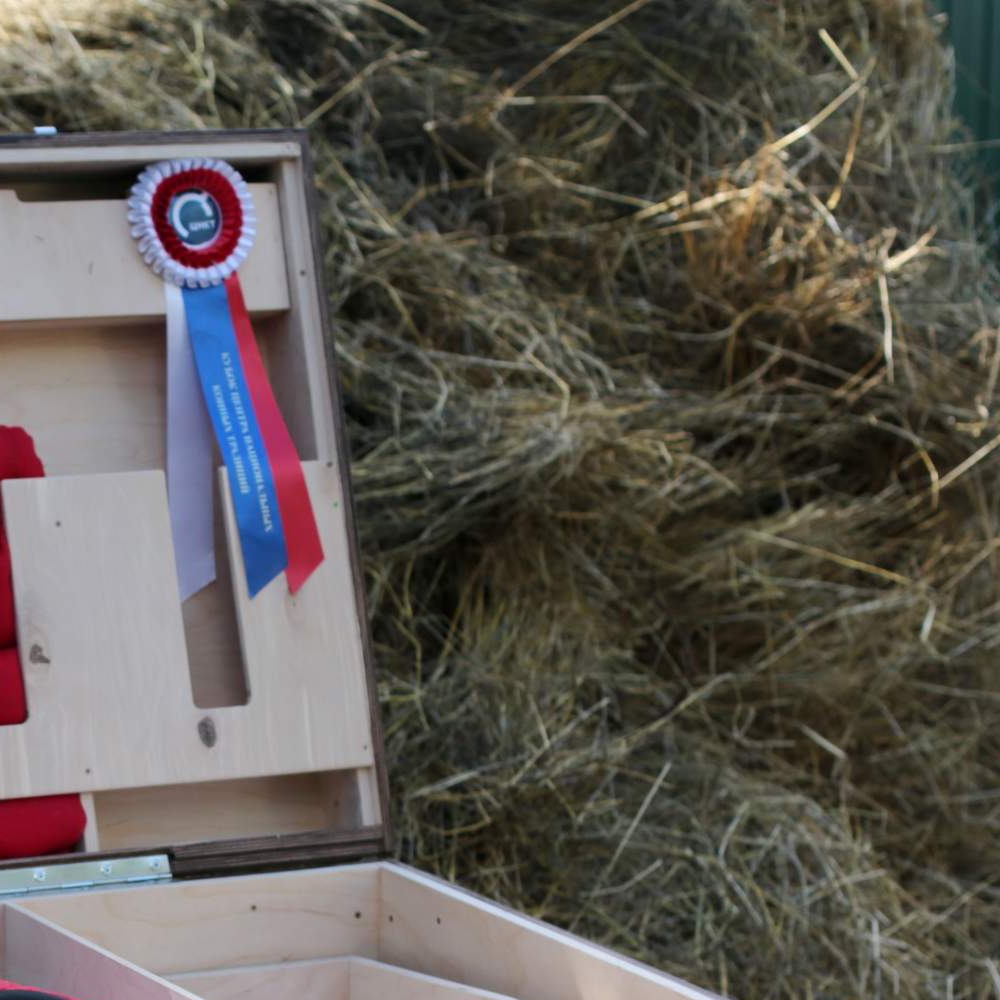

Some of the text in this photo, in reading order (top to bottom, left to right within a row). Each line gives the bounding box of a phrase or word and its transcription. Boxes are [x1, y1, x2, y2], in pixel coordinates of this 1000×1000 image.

[212, 384, 250, 494] КОННЫХ ТРАДИЦИЙ
[221, 352, 273, 533] КУБОК ЦЕНТРА НАЦИОНАЛЬНЫХ
